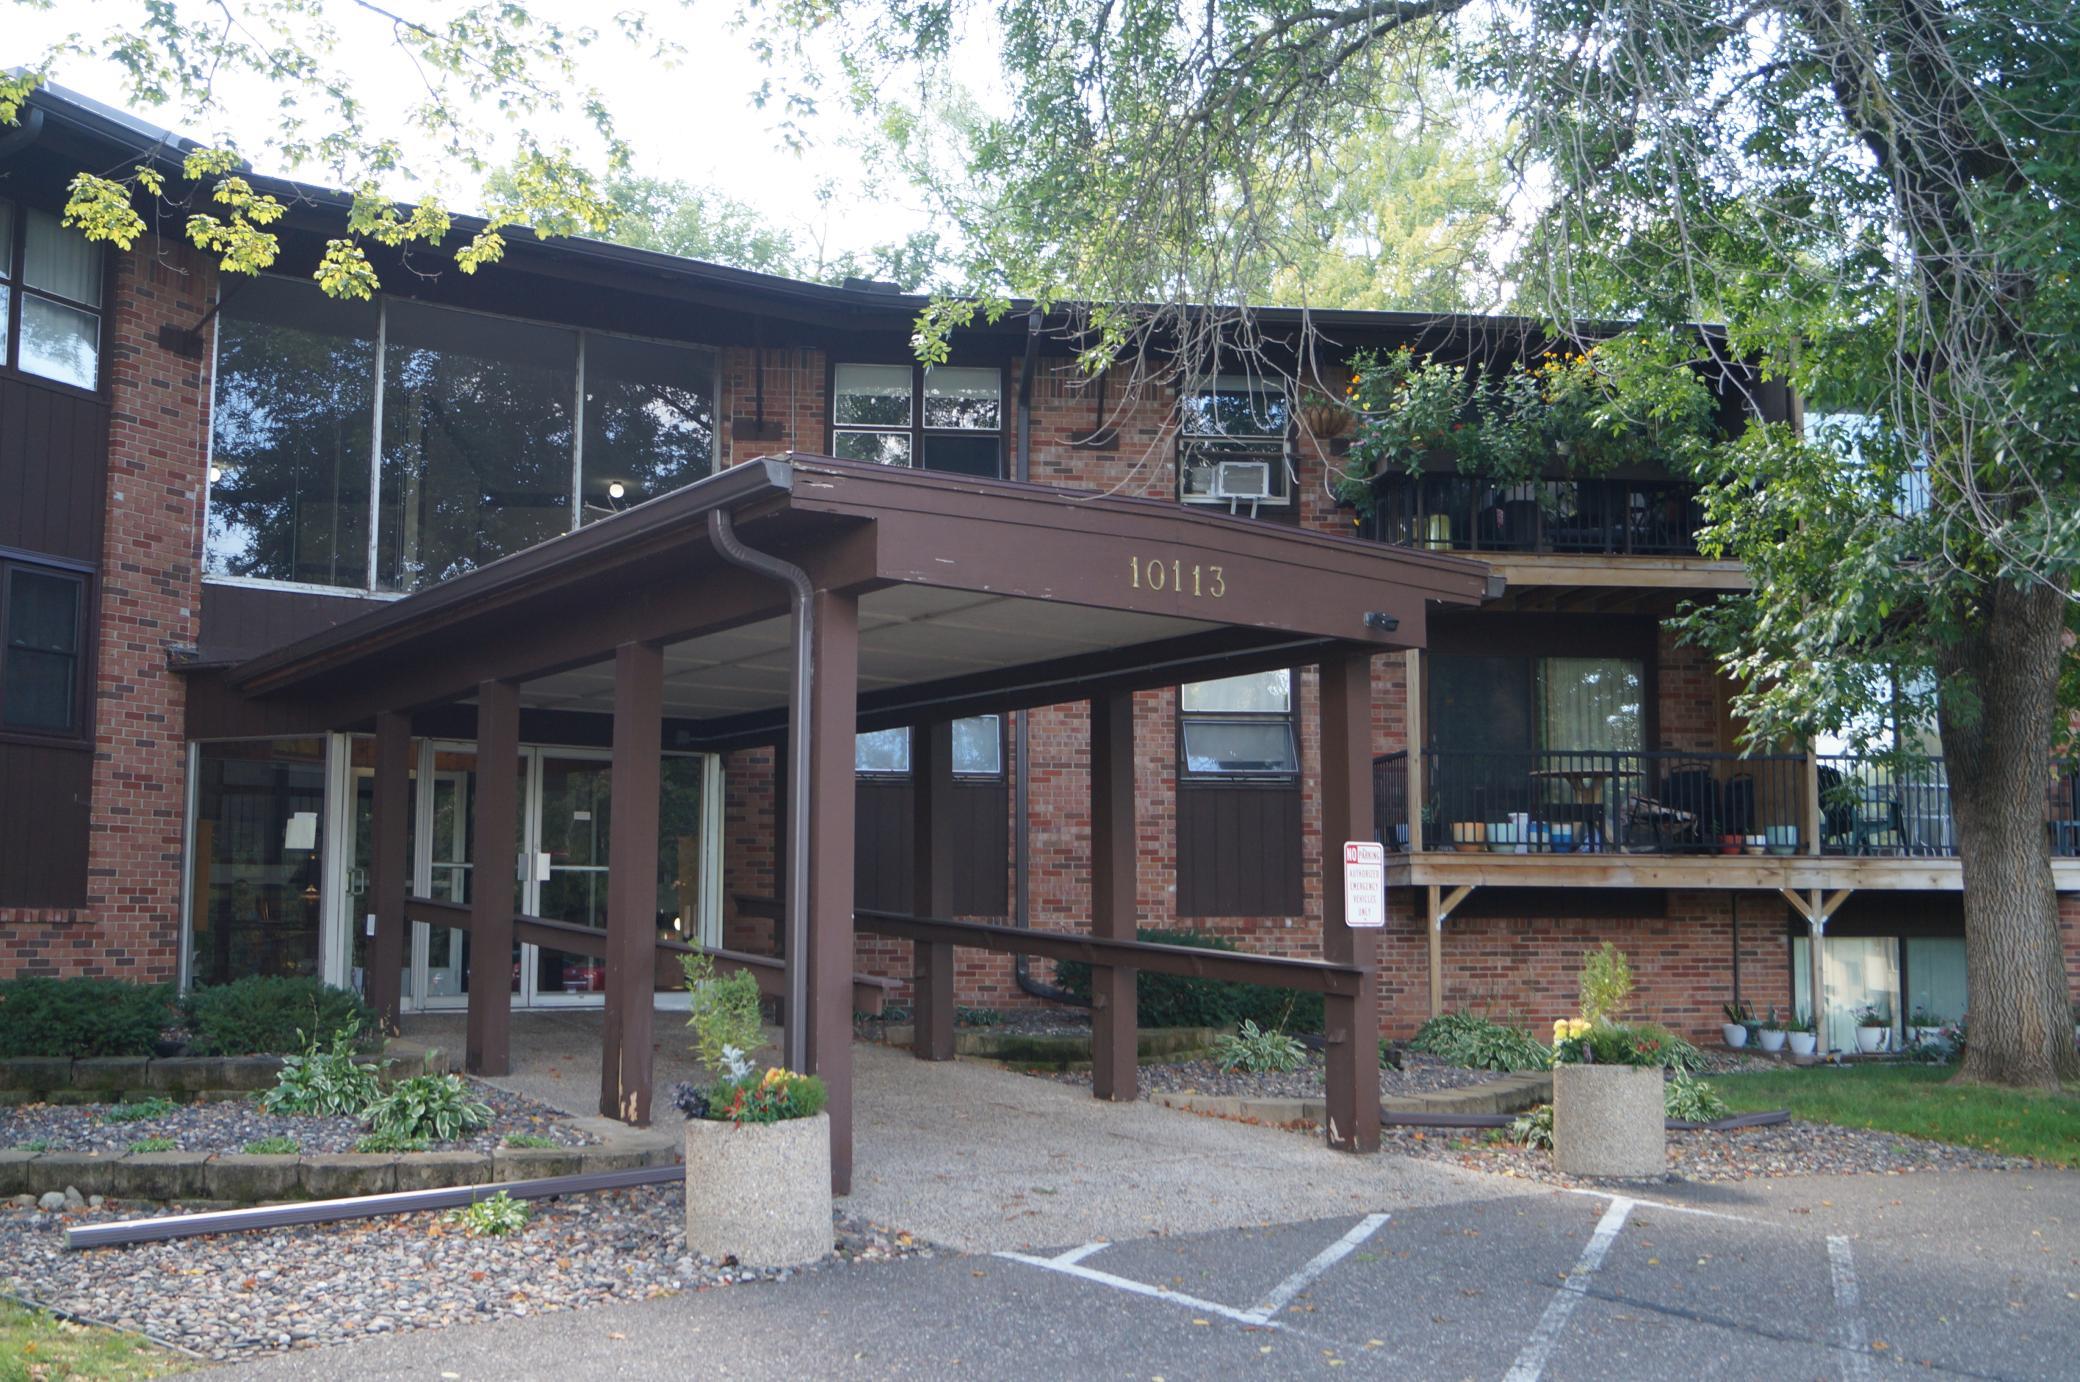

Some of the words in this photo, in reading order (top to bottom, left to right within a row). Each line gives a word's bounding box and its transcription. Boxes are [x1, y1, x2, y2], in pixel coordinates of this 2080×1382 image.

[1129, 556, 1225, 598] 10113
[1346, 847, 1358, 861] NO
[1359, 848, 1380, 860] PARKING
[1349, 869, 1379, 878] AUTHORIZED
[1350, 882, 1378, 891] EMERGENCY
[1353, 895, 1377, 904] VEHICLES
